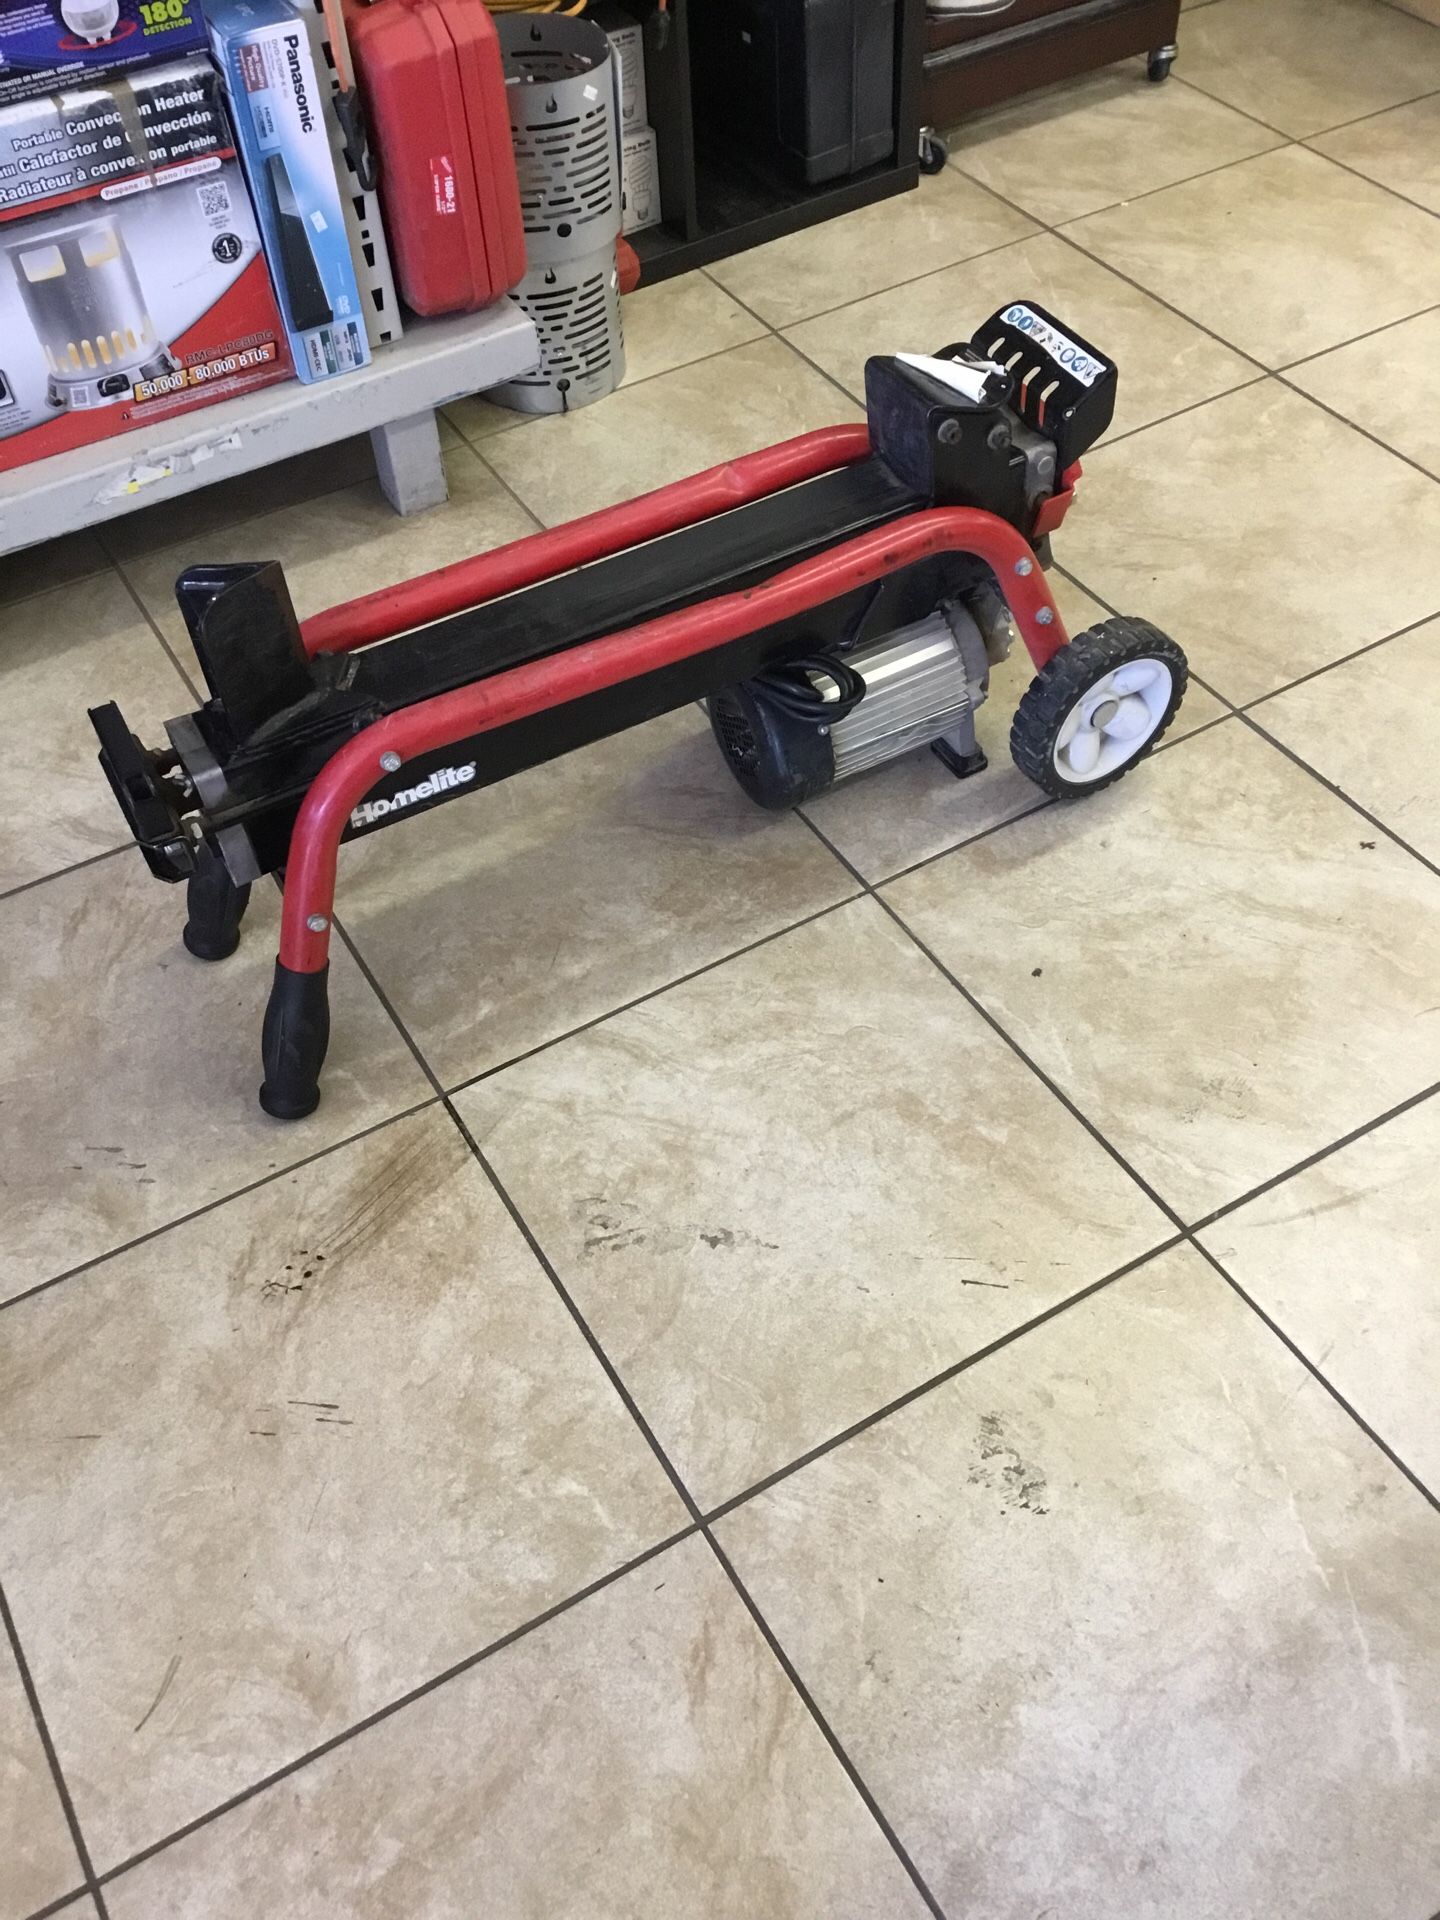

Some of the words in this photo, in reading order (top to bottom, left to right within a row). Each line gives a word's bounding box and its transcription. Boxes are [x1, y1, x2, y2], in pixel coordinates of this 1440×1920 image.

[143, 17, 192, 36] DETECTION
[284, 34, 313, 133] Panasonic
[13, 130, 63, 151] Portable
[65, 103, 152, 136] Convecn
[154, 89, 205, 112] Heater
[19, 141, 98, 172] Calefactor
[102, 135, 122, 150] de
[125, 110, 212, 143] nvección
[0, 173, 72, 202] Radiateur
[76, 167, 87, 181] à
[90, 148, 168, 178] conveon
[170, 135, 218, 157] portable
[142, 375, 183, 397] 50,000
[195, 358, 237, 380] 80,000
[238, 349, 271, 367] BTUs
[350, 764, 477, 829] Homelite
